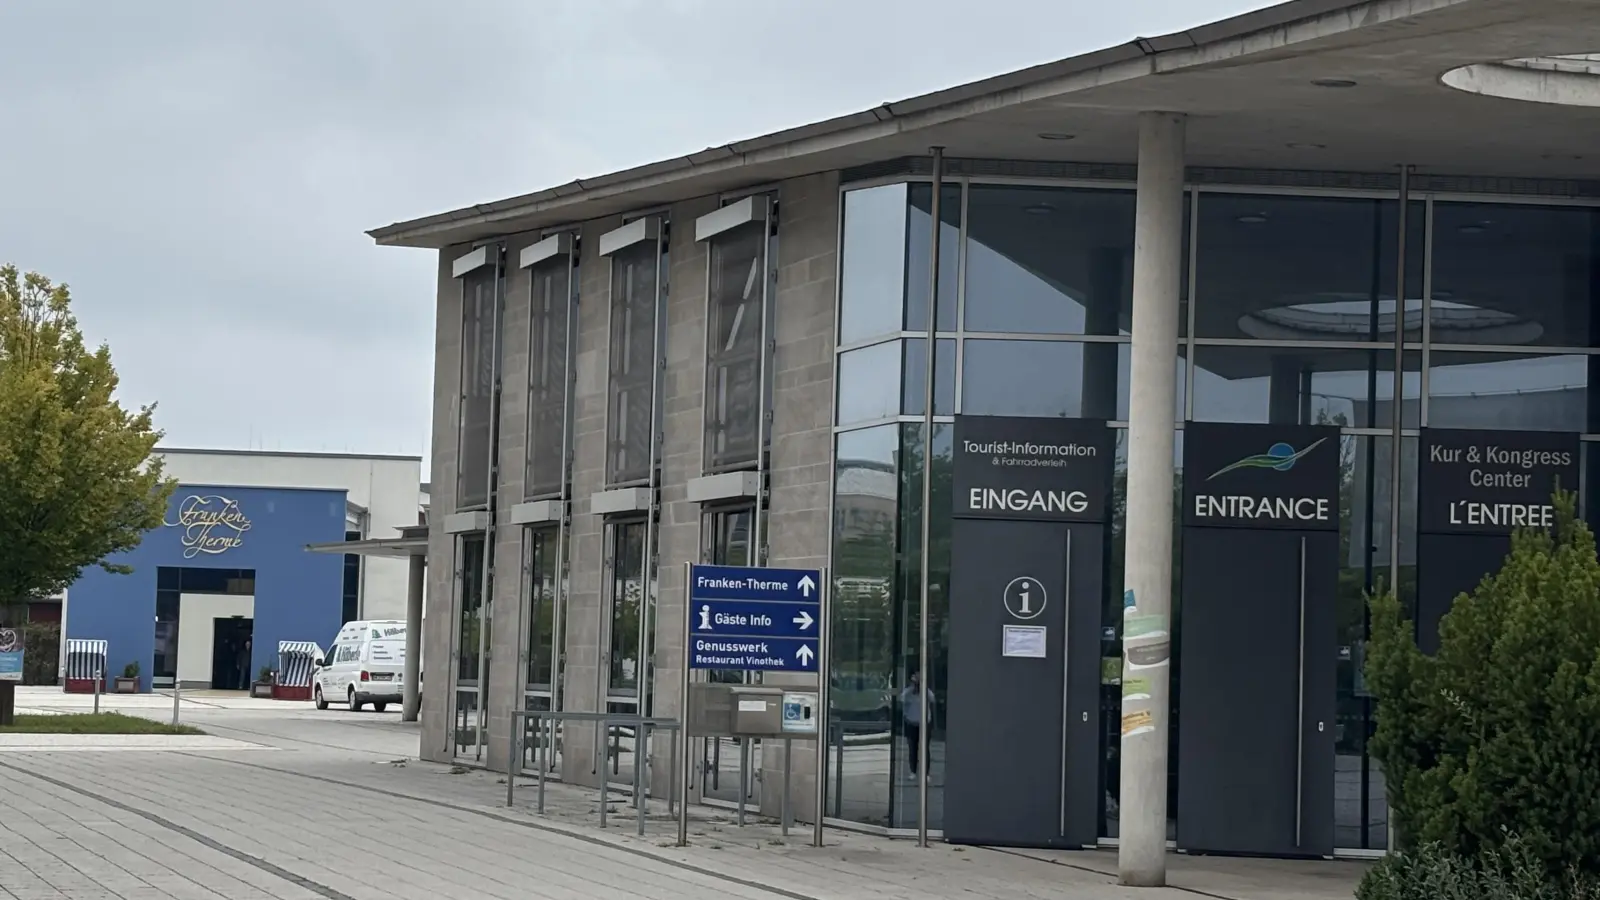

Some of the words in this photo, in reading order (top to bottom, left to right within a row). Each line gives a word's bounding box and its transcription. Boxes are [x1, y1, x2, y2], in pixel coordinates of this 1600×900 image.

[963, 440, 1097, 456] Tourist-Information
[1430, 444, 1462, 462] Kur
[1466, 445, 1481, 463] &
[1486, 446, 1571, 468] Kongress
[991, 456, 1000, 466] &
[1001, 456, 1067, 468] Fahrradverleih
[1469, 468, 1531, 488] Center
[969, 487, 1089, 513] EINGANG
[1195, 494, 1329, 520] ENTRANCE
[163, 495, 252, 531] Franken
[697, 576, 788, 591] Franken-Therme
[714, 612, 747, 626] Gäste
[750, 614, 772, 627] Info
[696, 640, 768, 653] Genusswerk
[695, 654, 744, 665] Restaurant
[746, 655, 785, 666] Vinothek
